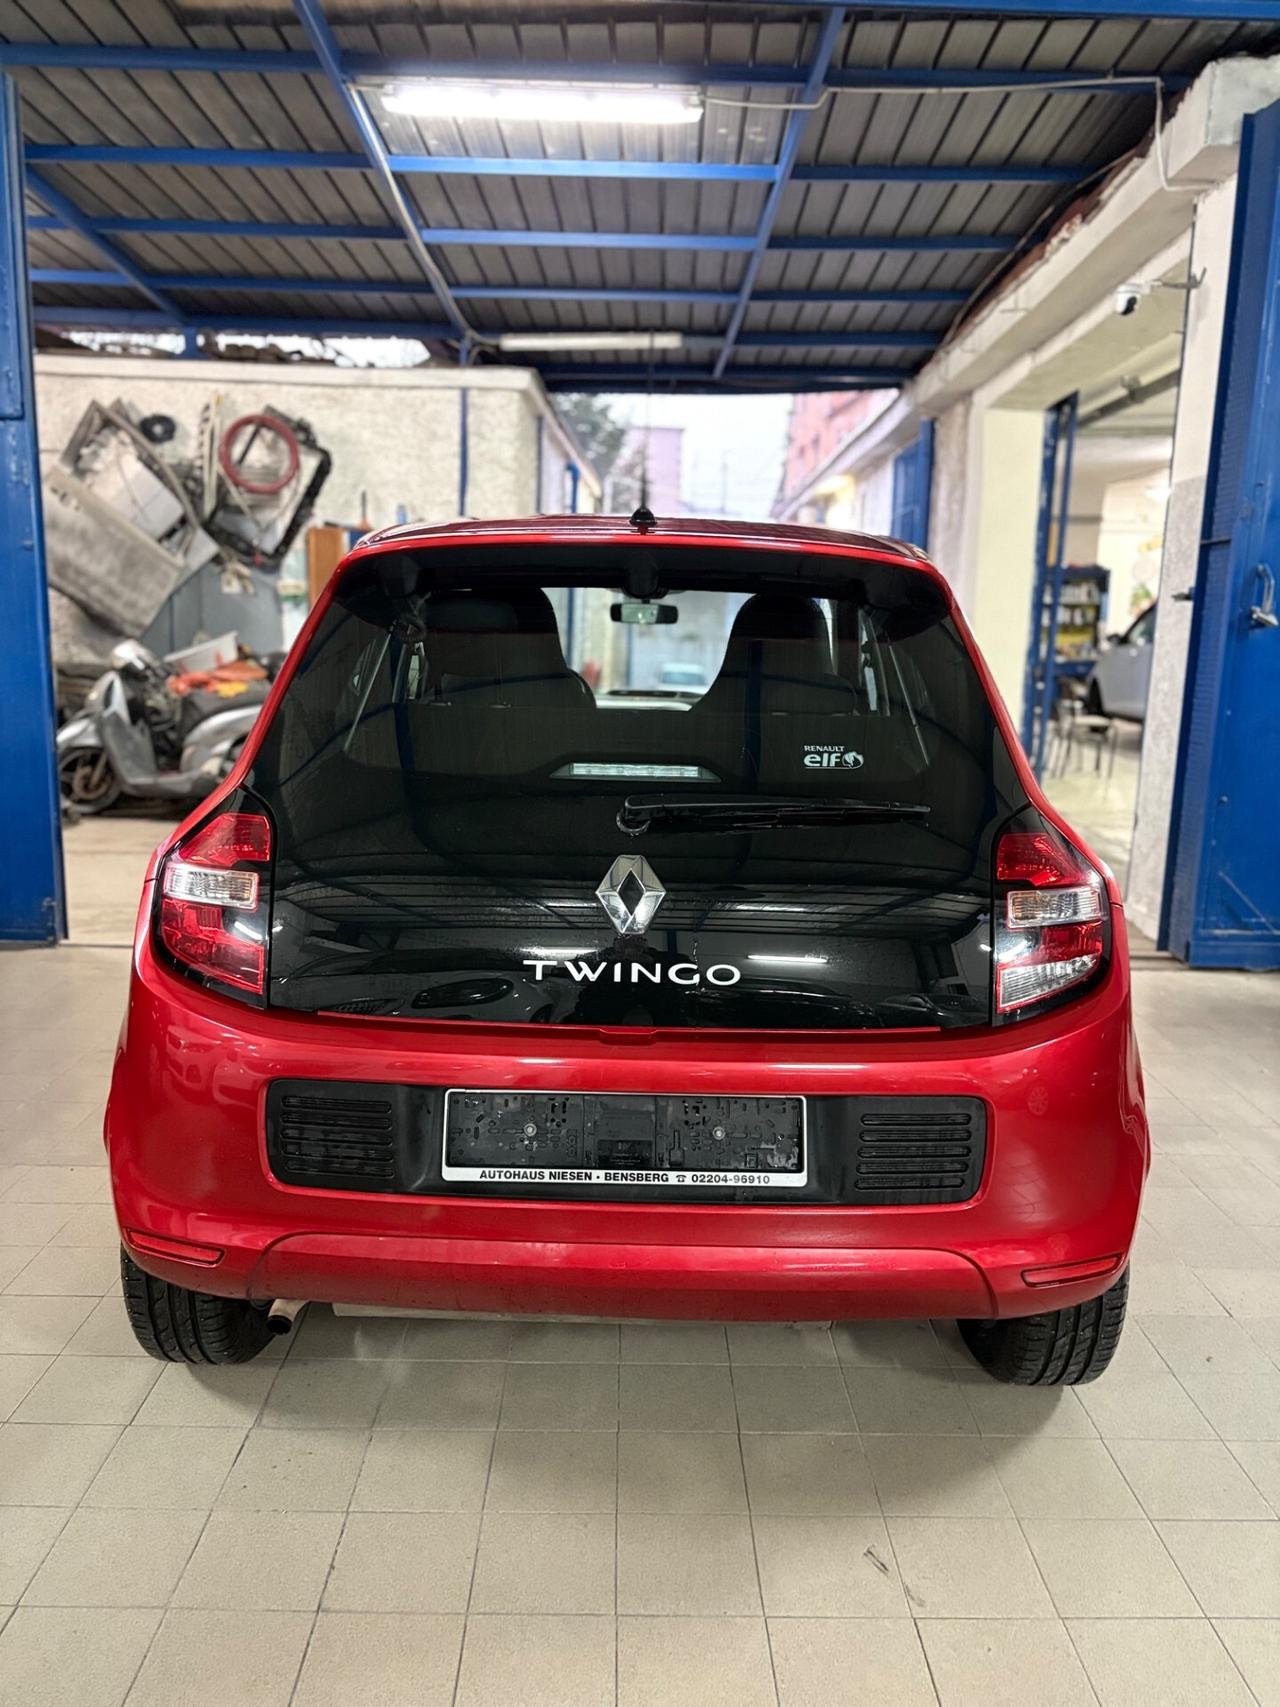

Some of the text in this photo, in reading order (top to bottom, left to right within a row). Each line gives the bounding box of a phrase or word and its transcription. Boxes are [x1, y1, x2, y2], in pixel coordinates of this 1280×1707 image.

[804, 753, 841, 767] elf
[523, 960, 741, 986] TWINGO
[480, 1170, 770, 1184] AUTOHAUS NIESEN BENSBERG 02204-96910
